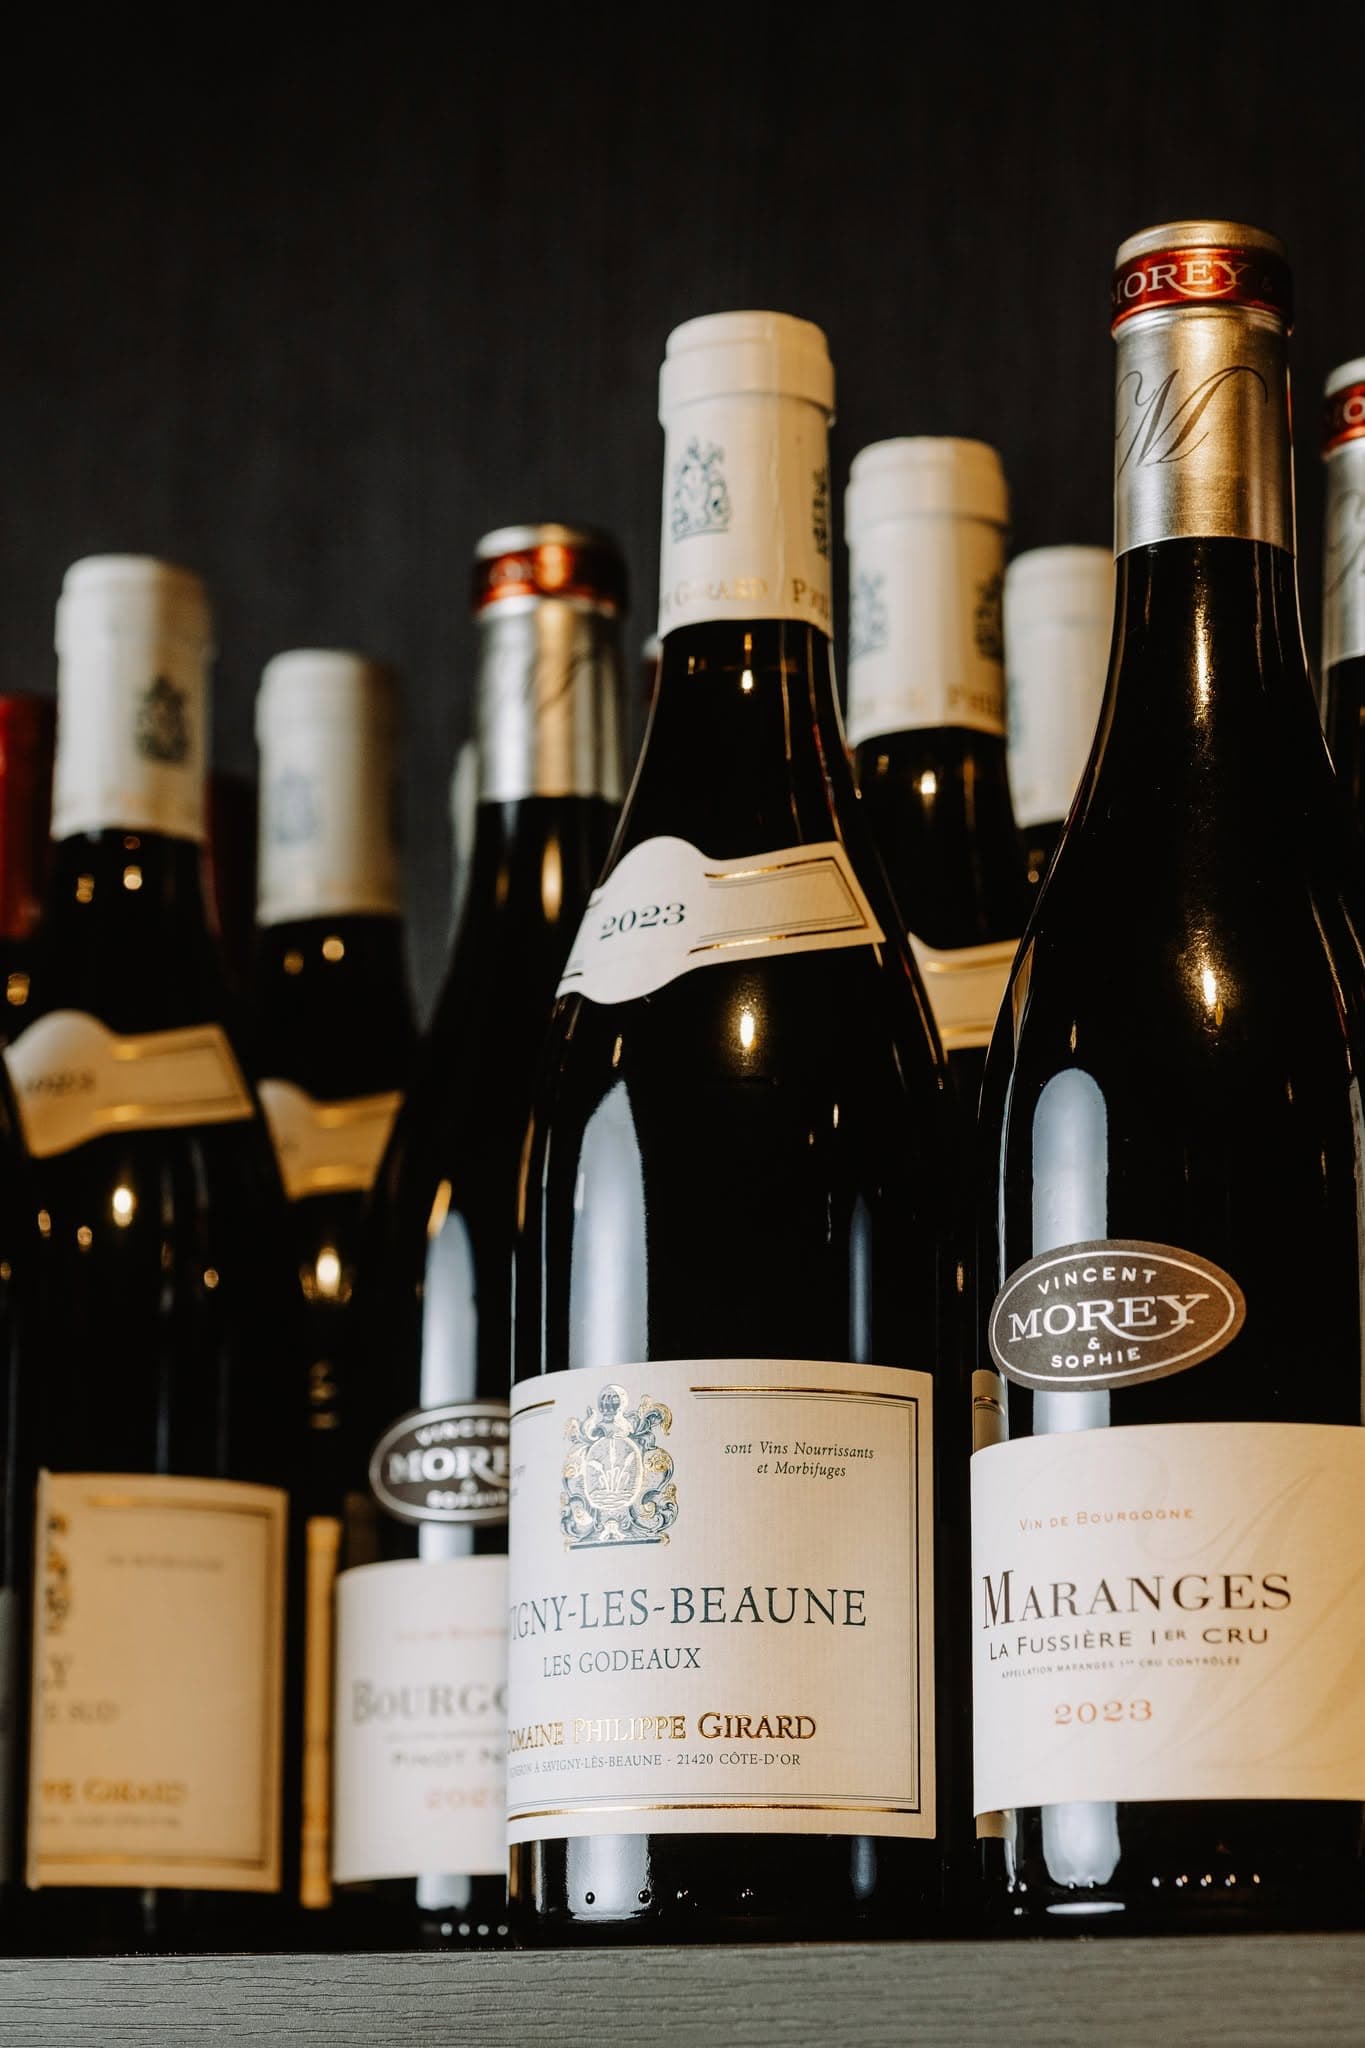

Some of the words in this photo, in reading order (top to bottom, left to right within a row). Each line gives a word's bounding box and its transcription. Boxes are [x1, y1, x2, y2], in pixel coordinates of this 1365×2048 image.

[600, 902, 686, 940] 2023
[1037, 1266, 1158, 1296] VINCENT
[1007, 1292, 1210, 1343] MOREY
[1051, 1346, 1142, 1369] SOPHIE
[1087, 1337, 1100, 1350] &
[724, 1443, 752, 1455] sont
[760, 1441, 789, 1455] Vins
[794, 1441, 875, 1459] Nourrissants
[757, 1463, 768, 1474] et
[774, 1461, 847, 1479] Morbifuges
[1050, 1516, 1069, 1528] DE
[1076, 1508, 1195, 1526] BOURGOGNE
[509, 1586, 868, 1641] IGNY-LES-BEAUNE
[982, 1569, 1292, 1629] MARANGES
[990, 1642, 1009, 1661] LA
[1017, 1629, 1133, 1656] FUSSIÈRE
[1202, 1627, 1268, 1645] CRU
[543, 1653, 571, 1678] LES
[579, 1647, 701, 1673] GODEAUX
[1055, 1699, 1153, 1726] 2023
[573, 1714, 687, 1745] PHILIPPE
[698, 1711, 817, 1740] GIRARD
[677, 1753, 714, 1766] 21420
[719, 1751, 801, 1766] CÔTE-D'OR
